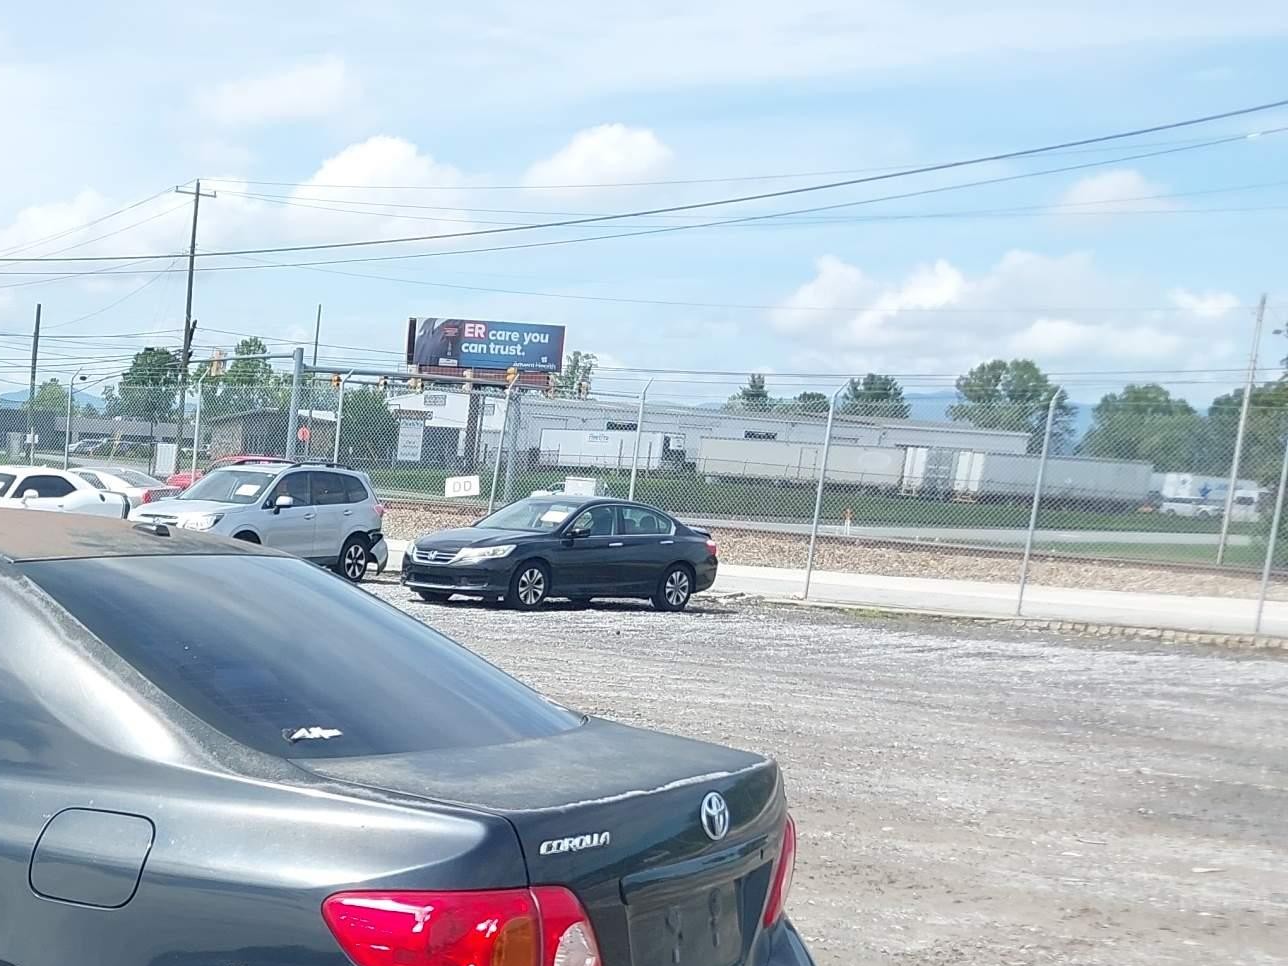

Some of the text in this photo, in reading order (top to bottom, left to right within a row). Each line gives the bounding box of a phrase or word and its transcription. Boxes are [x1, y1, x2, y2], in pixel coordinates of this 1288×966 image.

[464, 323, 485, 338] ER
[489, 330, 519, 341] care
[523, 332, 549, 345] you
[461, 342, 525, 356] can trust.
[539, 831, 610, 855] COROLLA
